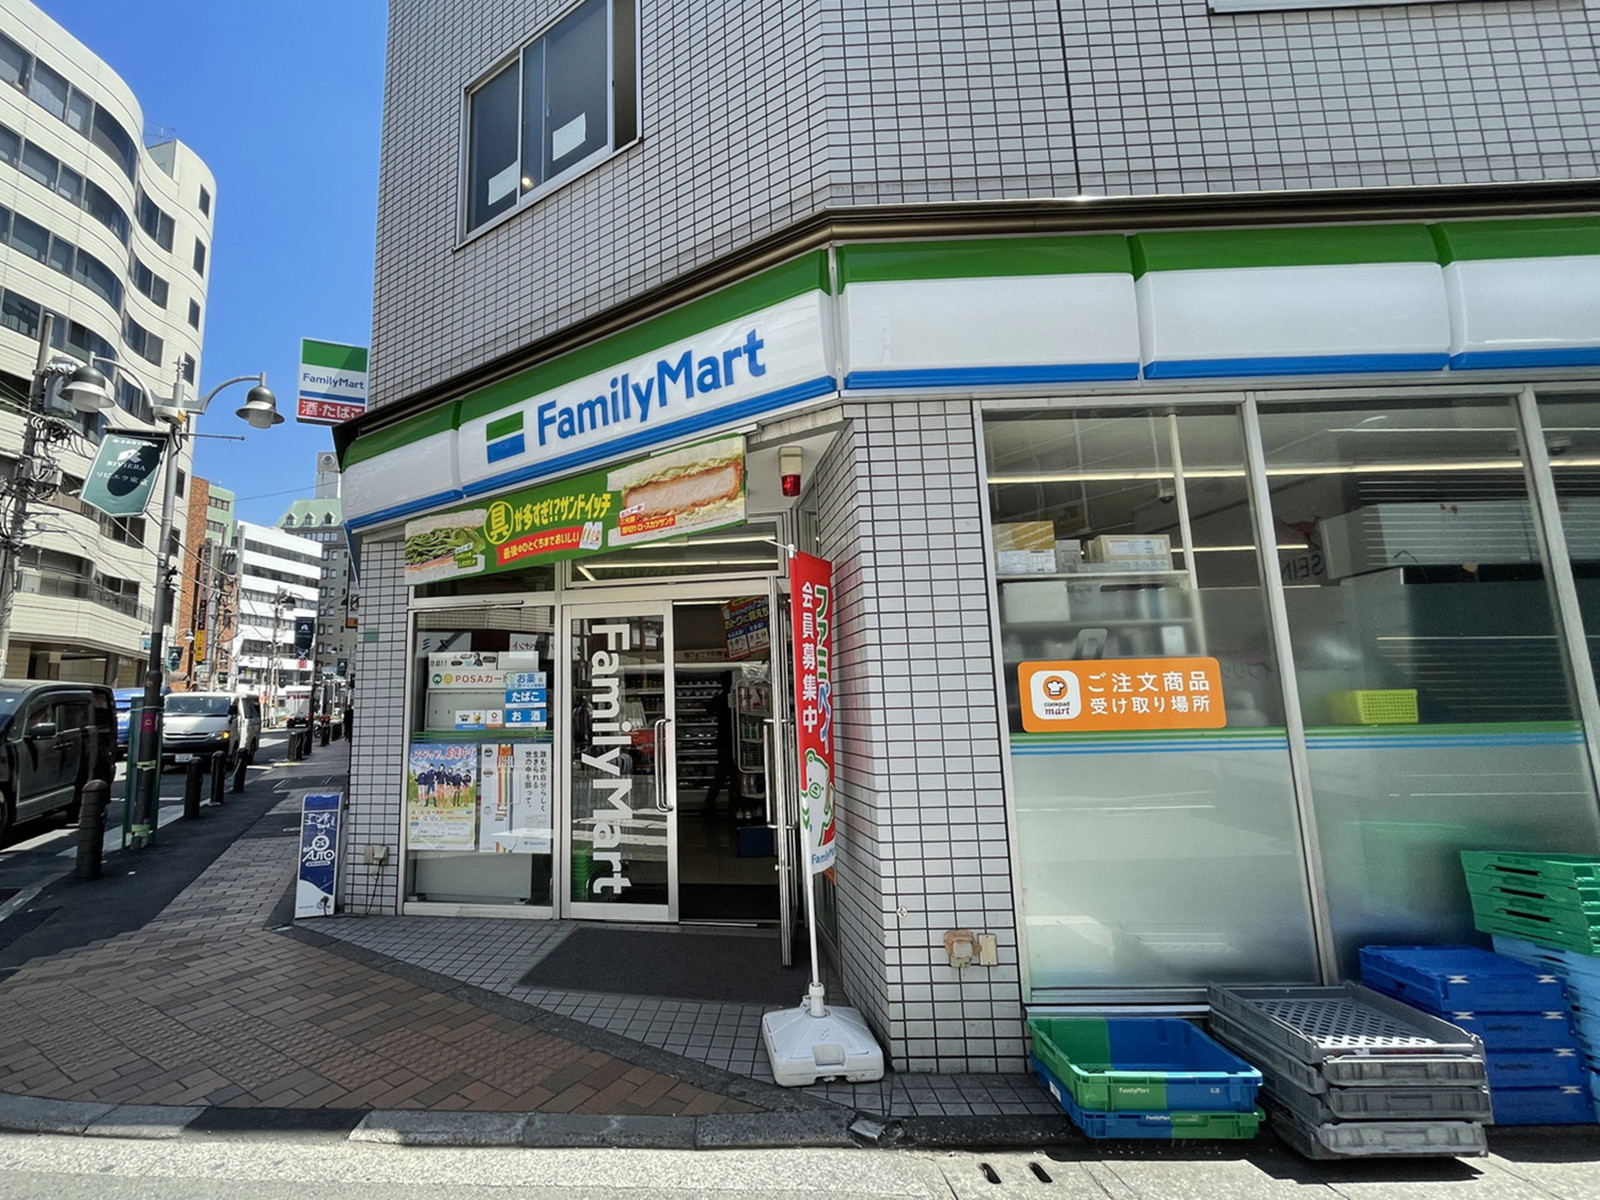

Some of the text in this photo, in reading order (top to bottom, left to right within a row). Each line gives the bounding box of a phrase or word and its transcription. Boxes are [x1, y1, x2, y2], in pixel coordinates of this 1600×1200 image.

[303, 373, 365, 389] FamilyMart
[538, 329, 766, 446] FamilyMart
[106, 460, 146, 471] RIVIERA
[503, 531, 580, 560] 最後のひとくちまでおいしい
[801, 581, 818, 734] 会員募集中
[1088, 671, 1211, 693] ご注文商品
[511, 691, 540, 702] たばこ
[1089, 695, 1211, 715] 受け取り場所
[1045, 707, 1070, 715] mart
[581, 623, 633, 894] FamilyMart
[539, 751, 547, 812] 誰もが自分らしく
